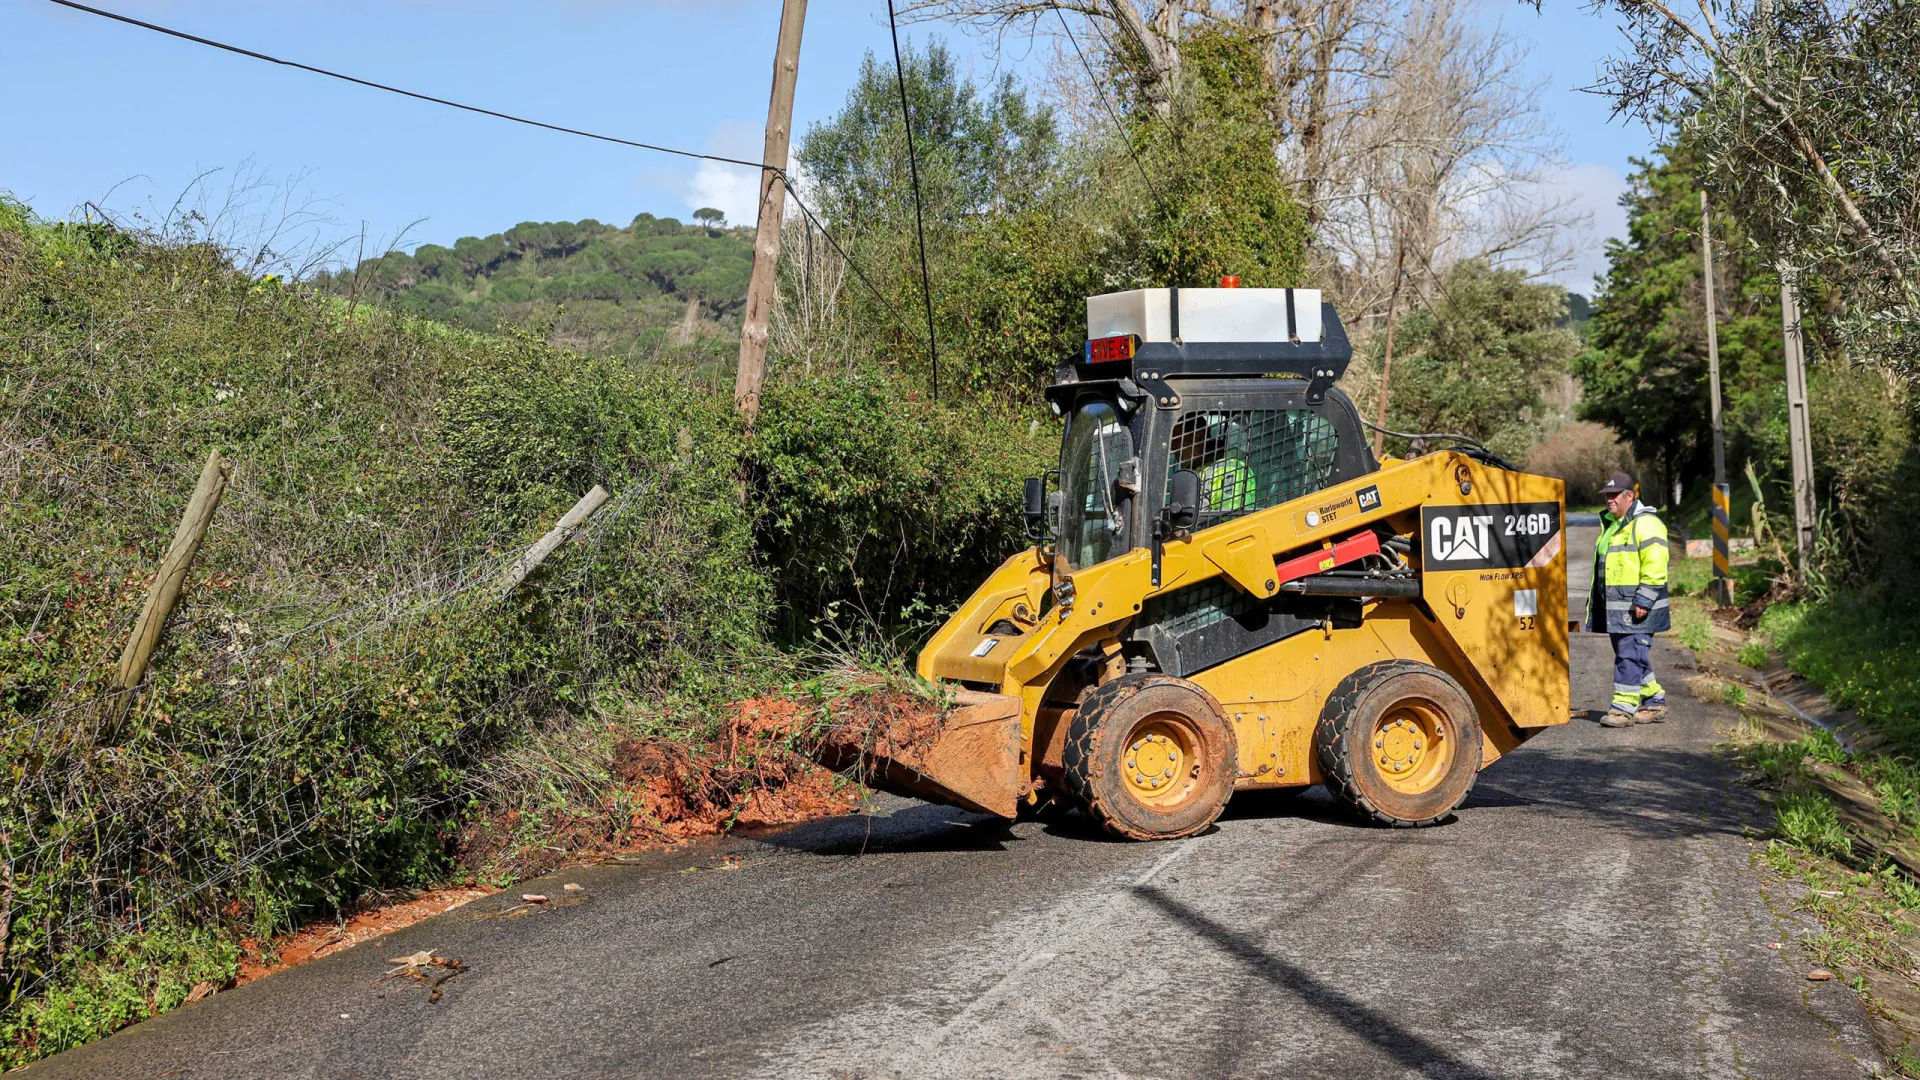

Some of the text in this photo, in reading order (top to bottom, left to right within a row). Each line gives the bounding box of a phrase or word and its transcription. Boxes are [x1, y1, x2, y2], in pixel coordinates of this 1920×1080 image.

[1319, 497, 1353, 514] Barloworld
[1359, 490, 1378, 507] CAT
[1322, 512, 1337, 523] STET
[1431, 513, 1551, 561] CAT 246D
[1520, 617, 1534, 630] 52
